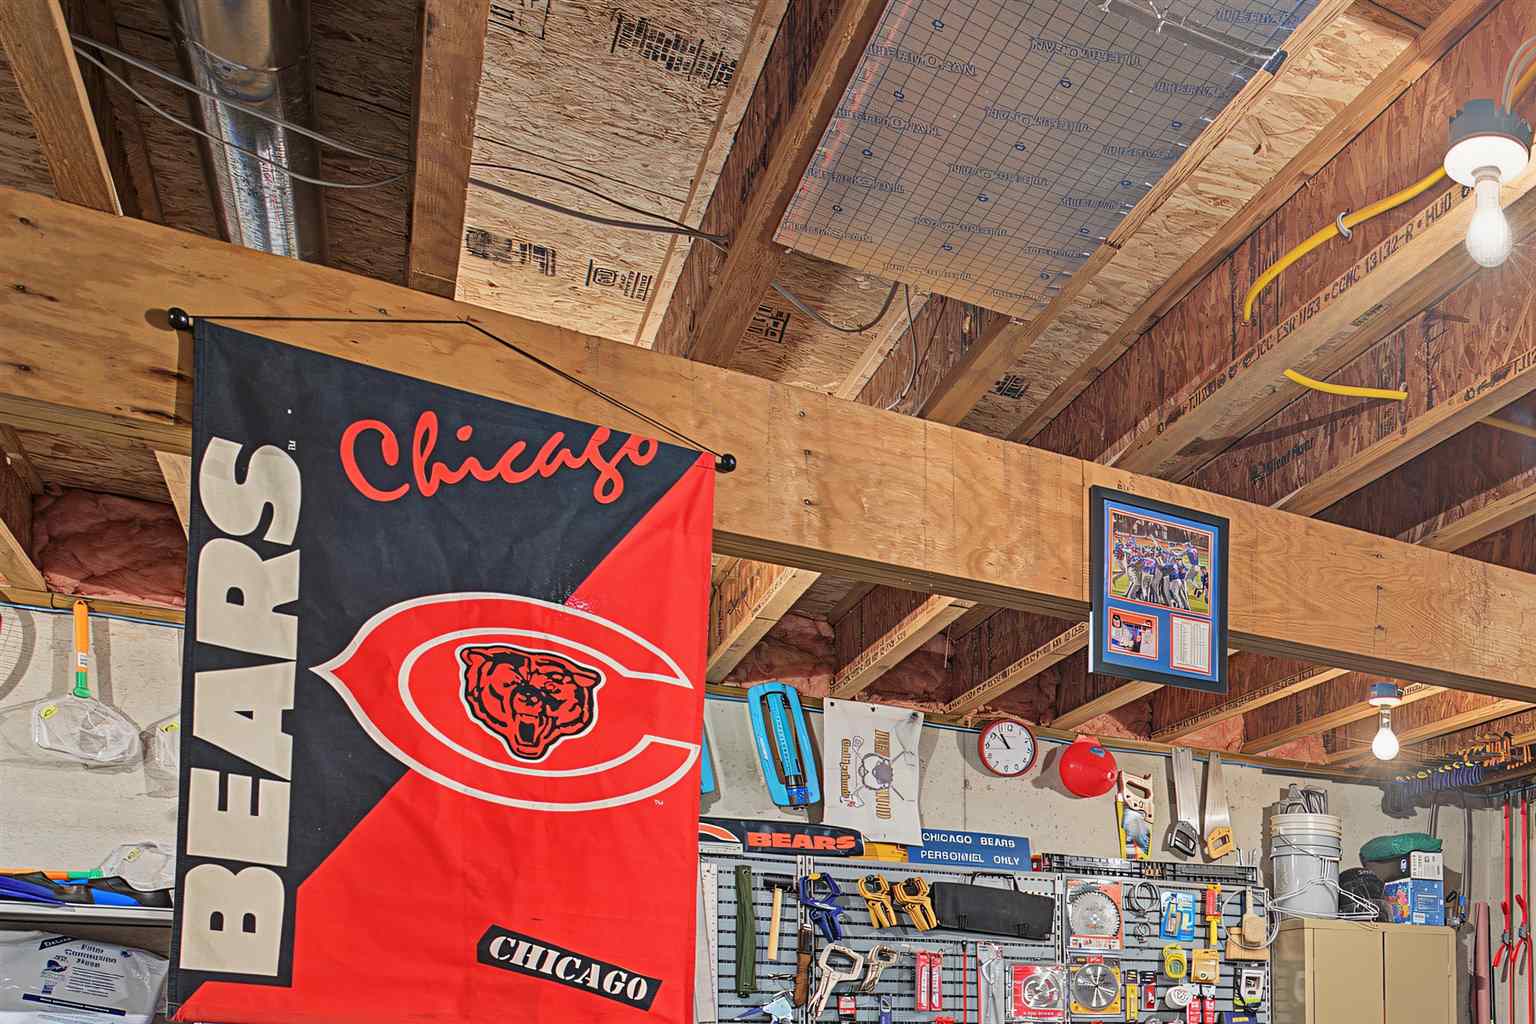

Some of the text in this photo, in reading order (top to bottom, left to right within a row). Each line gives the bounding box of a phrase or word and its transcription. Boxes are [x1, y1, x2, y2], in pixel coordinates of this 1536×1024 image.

[339, 410, 659, 504] Chicago
[180, 437, 302, 977] BEARS
[747, 832, 856, 850] BEARS
[920, 849, 1020, 867] PERSONNEL ONLY
[922, 833, 1016, 849] CHICAGO BEARS
[487, 934, 650, 1002] CHICAGO
